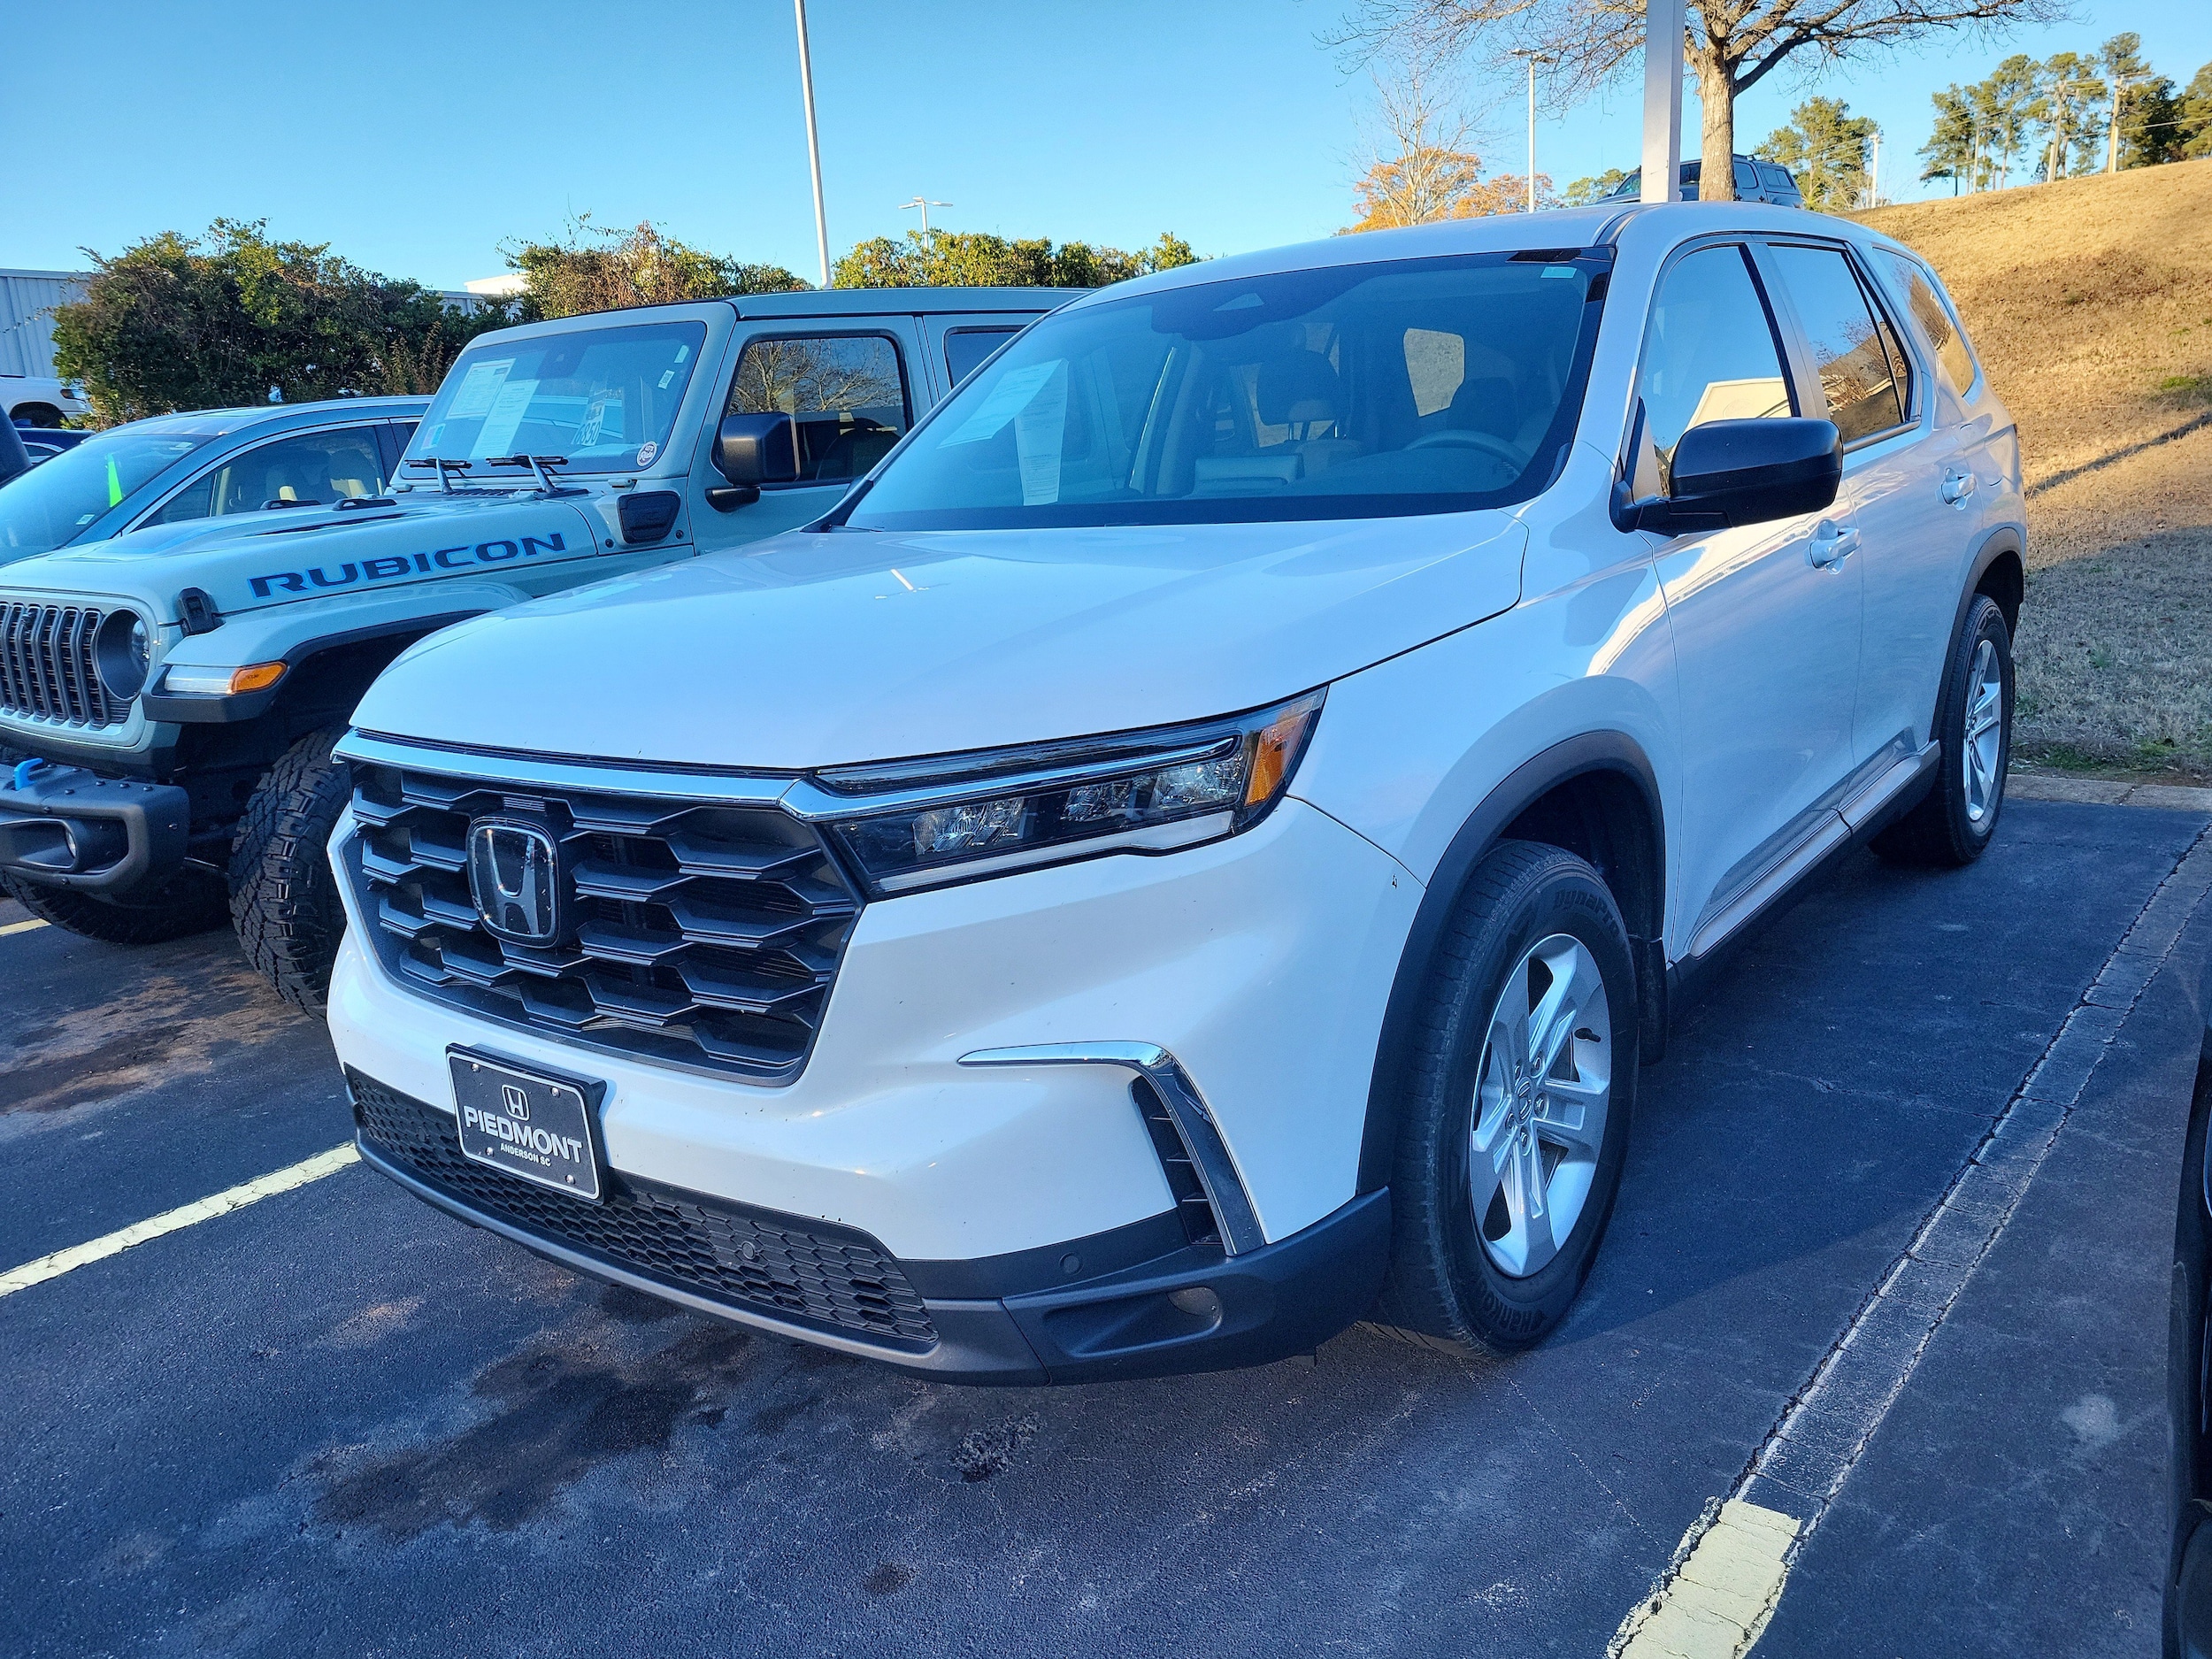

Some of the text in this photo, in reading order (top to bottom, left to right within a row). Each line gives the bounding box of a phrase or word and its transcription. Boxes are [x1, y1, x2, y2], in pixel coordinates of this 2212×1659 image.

[249, 532, 567, 599] RUBICON
[463, 1105, 582, 1164] PIEDMONT
[500, 1142, 551, 1167] ANDERSON SC
